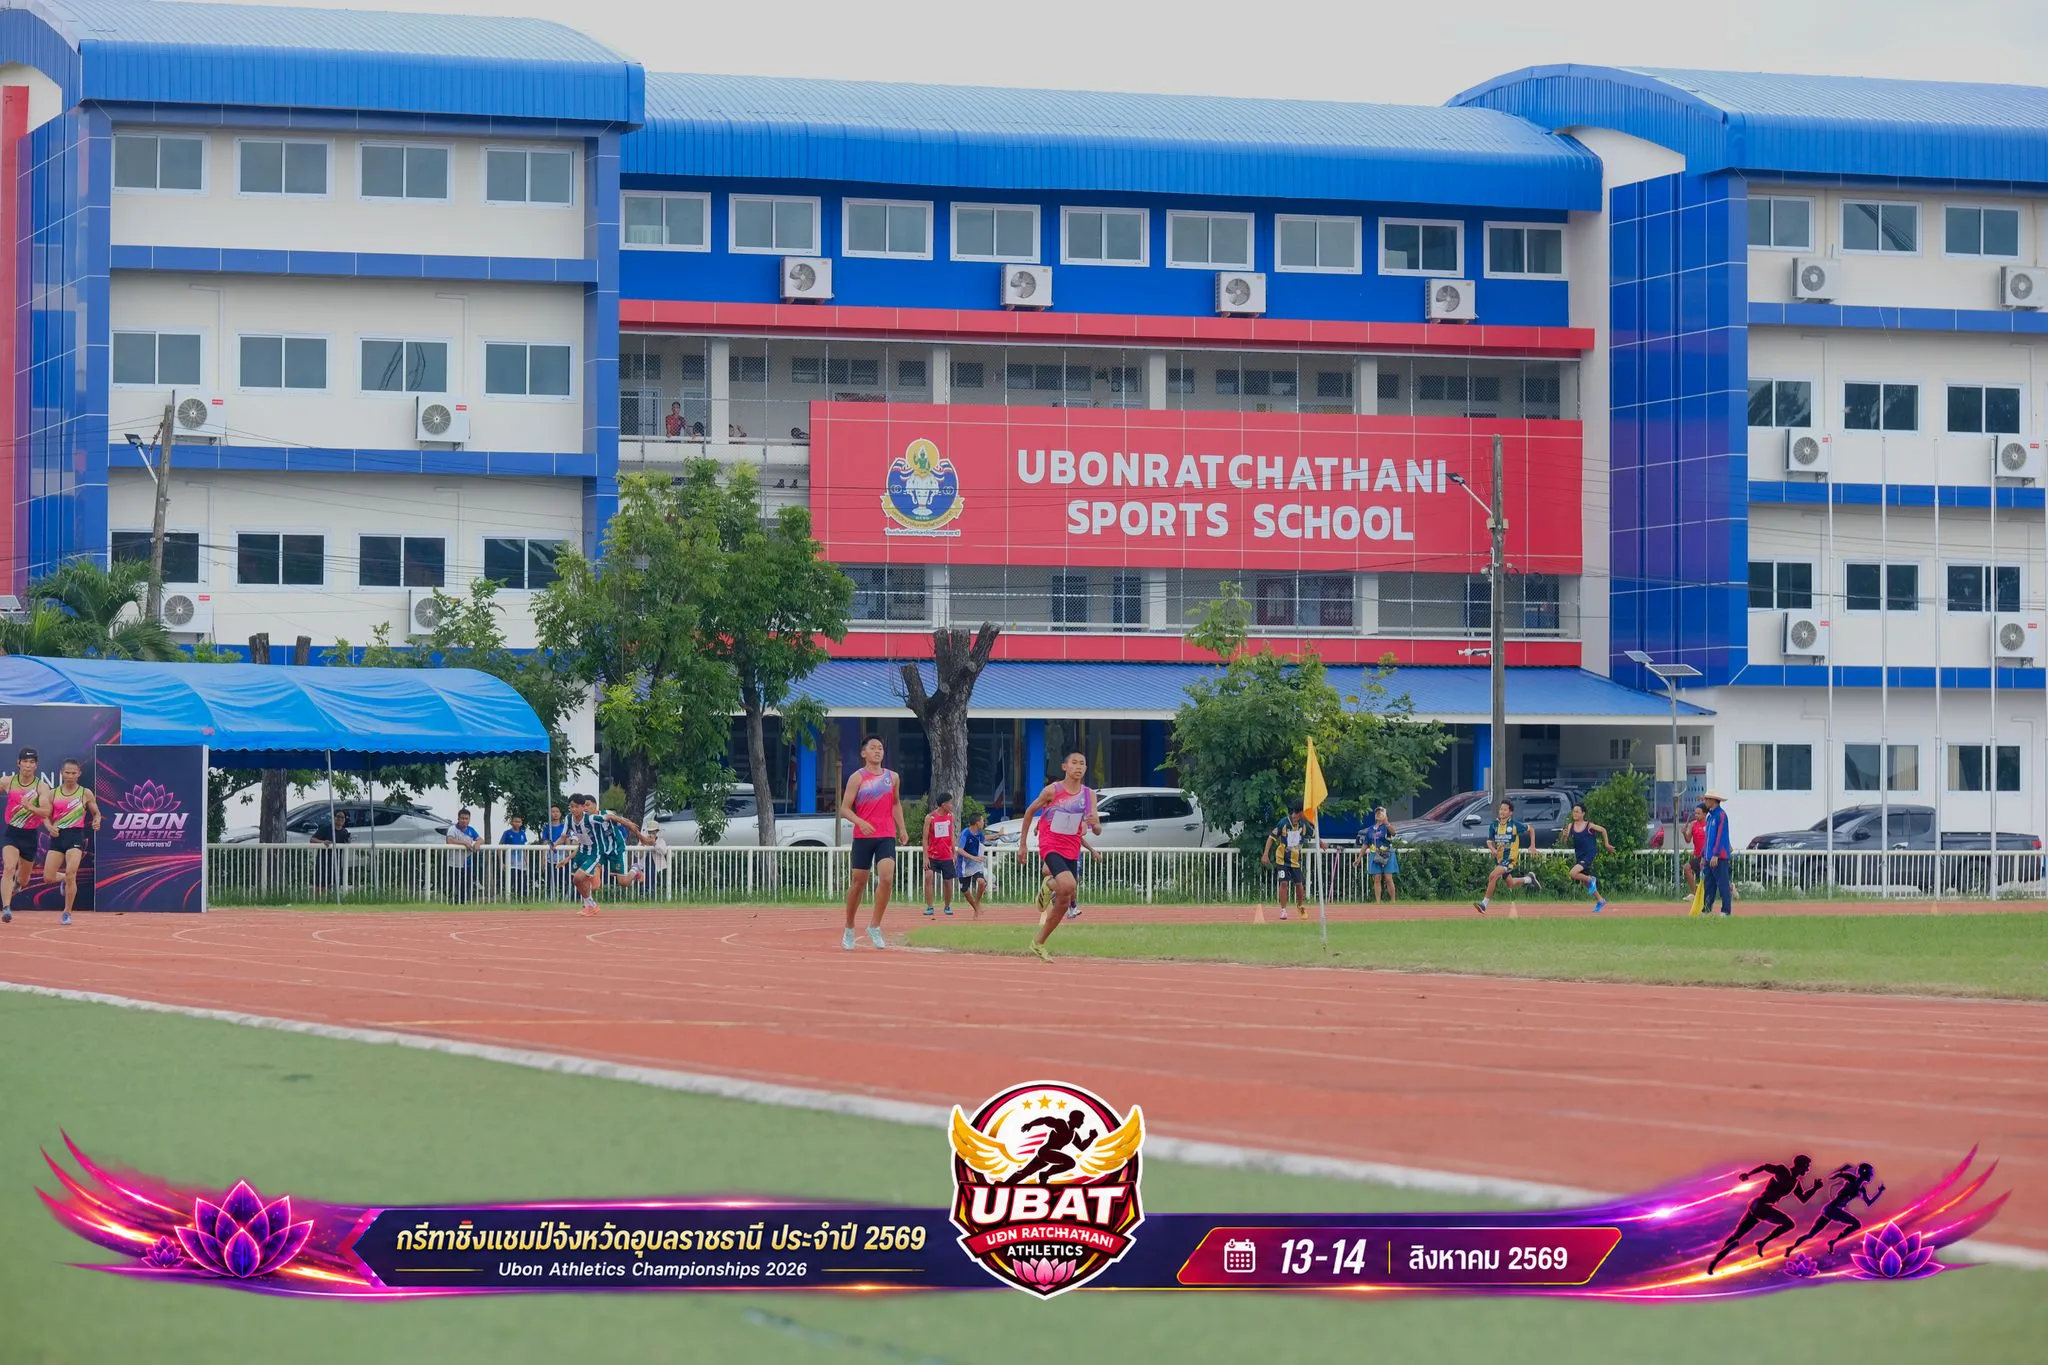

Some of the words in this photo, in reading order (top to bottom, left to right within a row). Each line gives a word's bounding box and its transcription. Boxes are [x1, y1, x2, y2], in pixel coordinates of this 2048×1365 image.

[1017, 449, 1447, 494] UBONRATCHATHANI
[1067, 500, 1229, 537] SPORTS
[1253, 503, 1414, 541] SCHOOL
[112, 812, 190, 830] UBON
[113, 830, 185, 840] ATHLETICS
